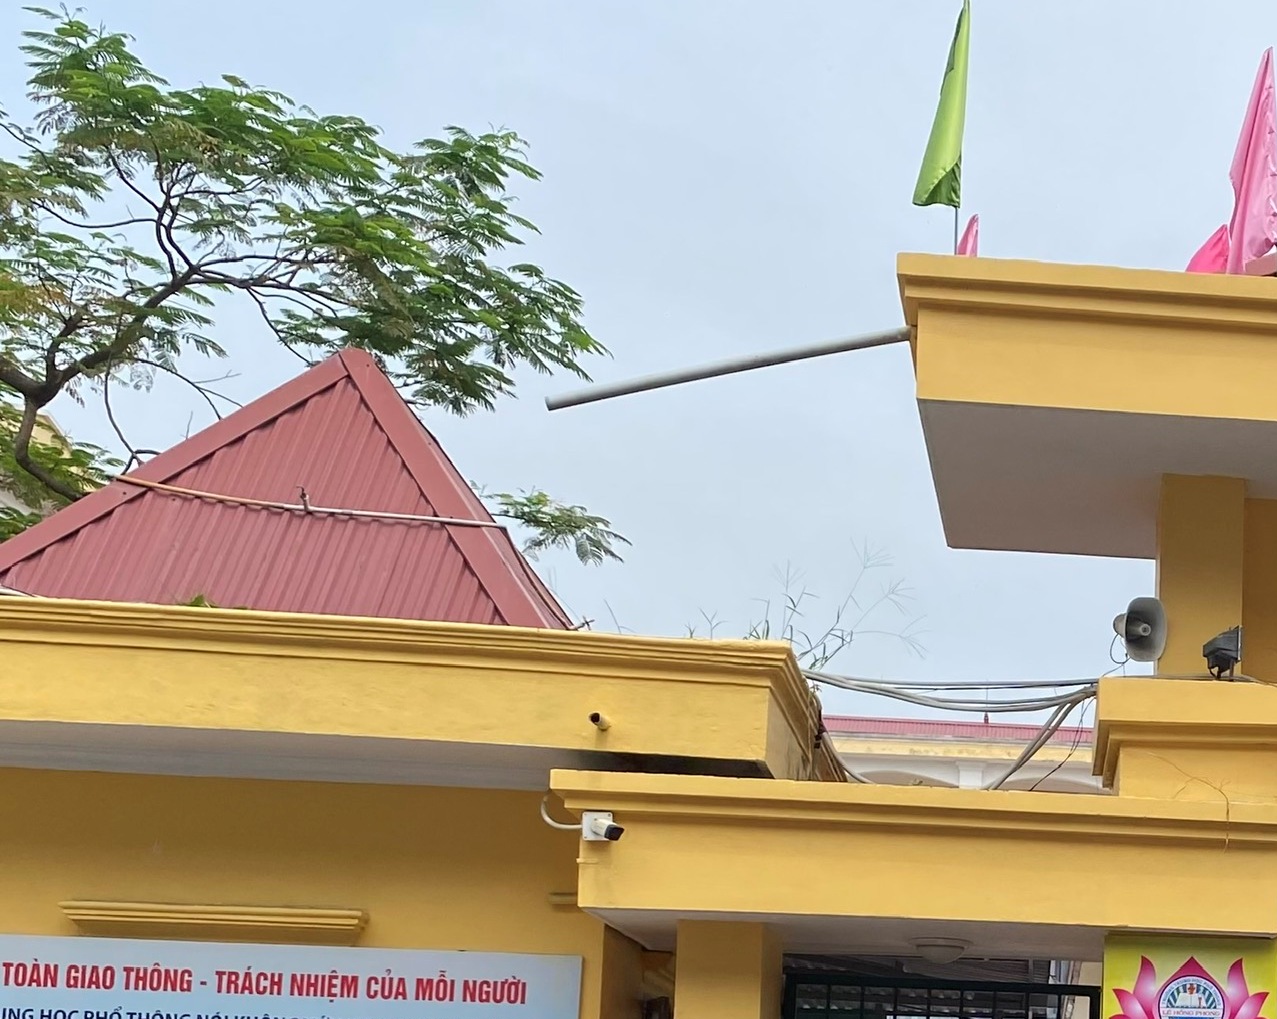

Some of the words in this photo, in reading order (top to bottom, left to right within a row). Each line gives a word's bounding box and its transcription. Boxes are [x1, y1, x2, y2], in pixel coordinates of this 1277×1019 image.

[2, 958, 59, 988] TOÀN
[65, 964, 115, 990] GIAO
[123, 963, 193, 992] THÔNG
[215, 965, 283, 996] TRÁCH
[290, 969, 358, 1002] NHIỆM
[366, 968, 407, 1000] CỦA
[415, 969, 455, 1003] MỖI
[462, 975, 527, 1004] NGƯỜI
